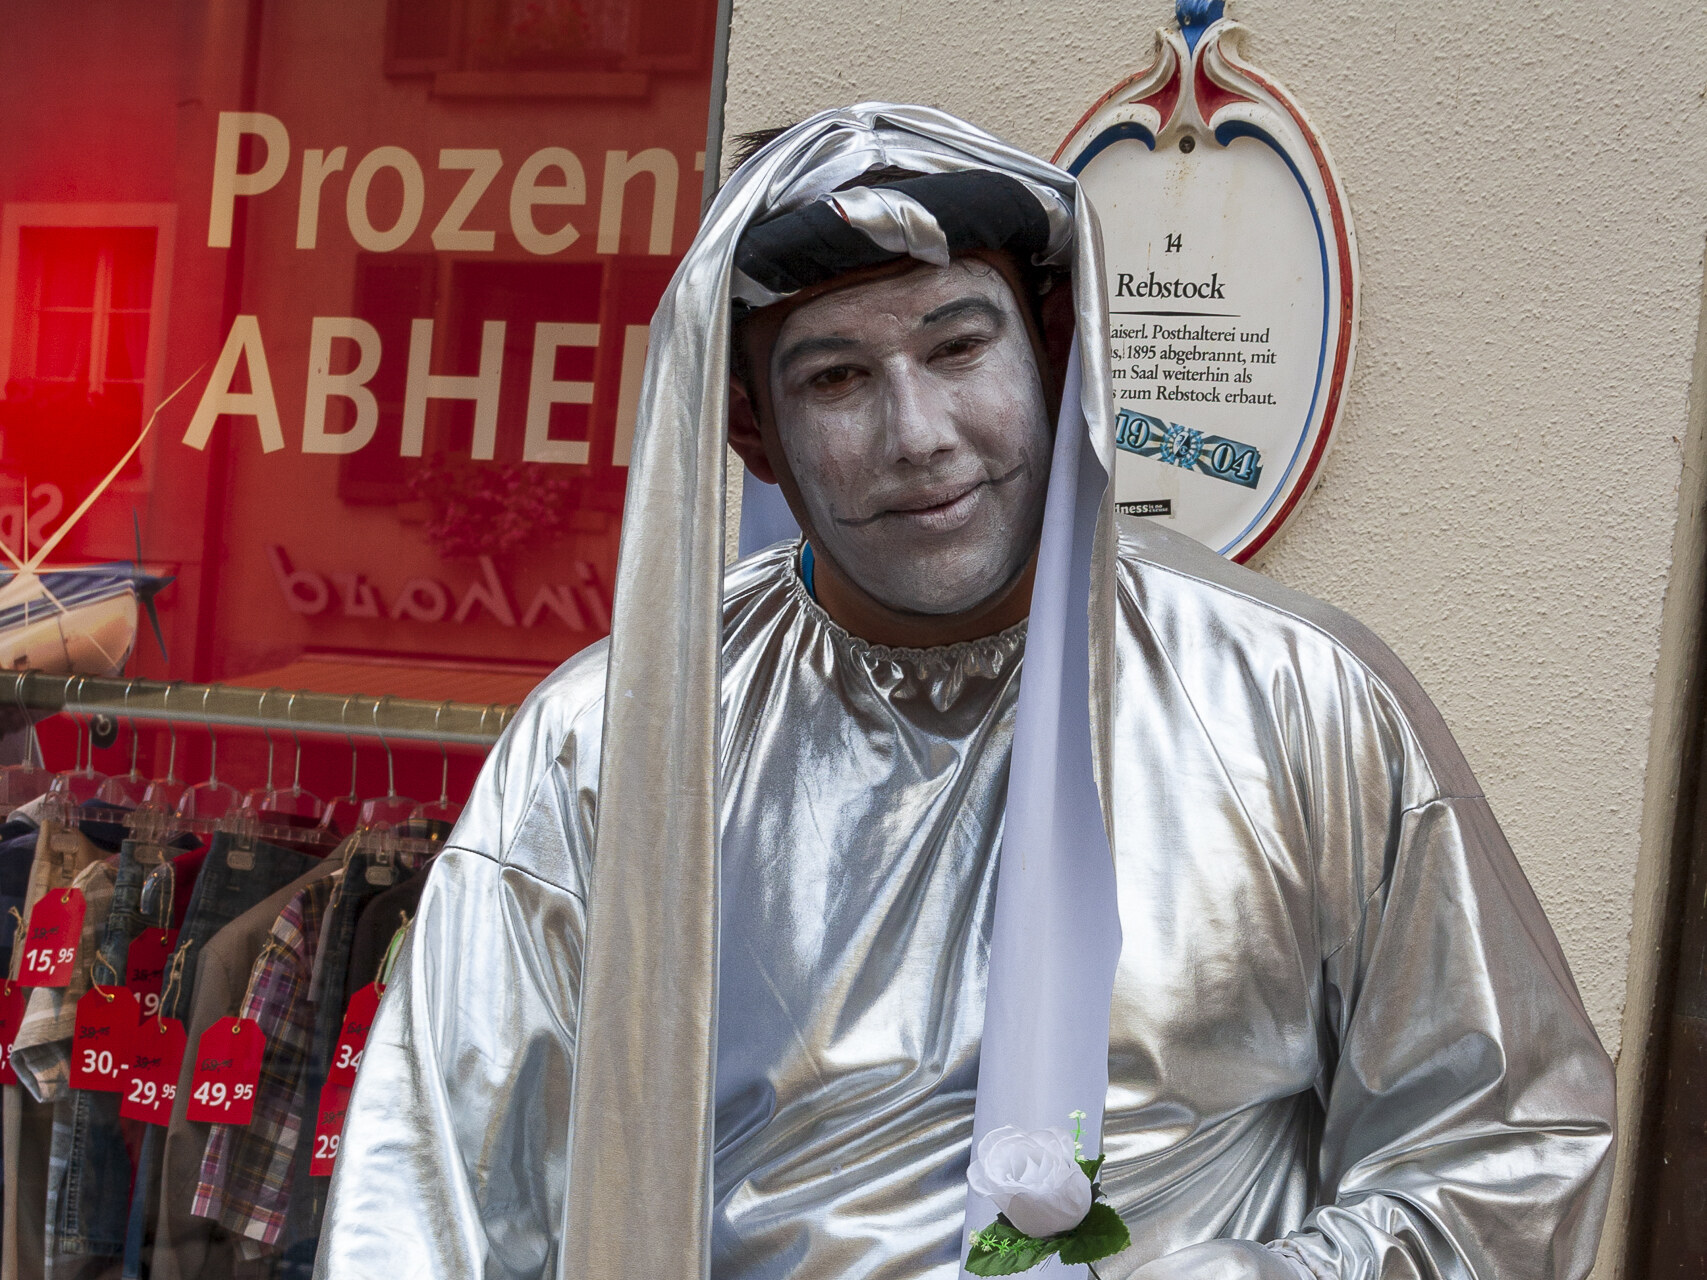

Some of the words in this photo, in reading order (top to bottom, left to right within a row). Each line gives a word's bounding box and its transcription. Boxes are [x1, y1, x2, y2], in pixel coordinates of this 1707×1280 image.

[207, 110, 706, 256] Prozen
[1164, 233, 1182, 253] 14
[1115, 271, 1225, 299] Rebstock
[1110, 323, 1148, 339] aiserl.
[1152, 324, 1236, 342] Posthalterei
[1240, 327, 1270, 343] und
[1127, 345, 1156, 360] 1895
[1160, 345, 1247, 365] abgebrannt,
[1250, 349, 1277, 364] mit
[1130, 364, 1158, 380] Saal
[1162, 365, 1229, 382] weiterhin
[1234, 367, 1253, 383] als
[1120, 389, 1151, 400] zum
[1156, 385, 1221, 402] Rebstock
[1225, 388, 1277, 405] erbaut.
[26, 947, 75, 975] 15,95
[128, 1078, 177, 1110] 29,95
[193, 1081, 254, 1111] 49,95
